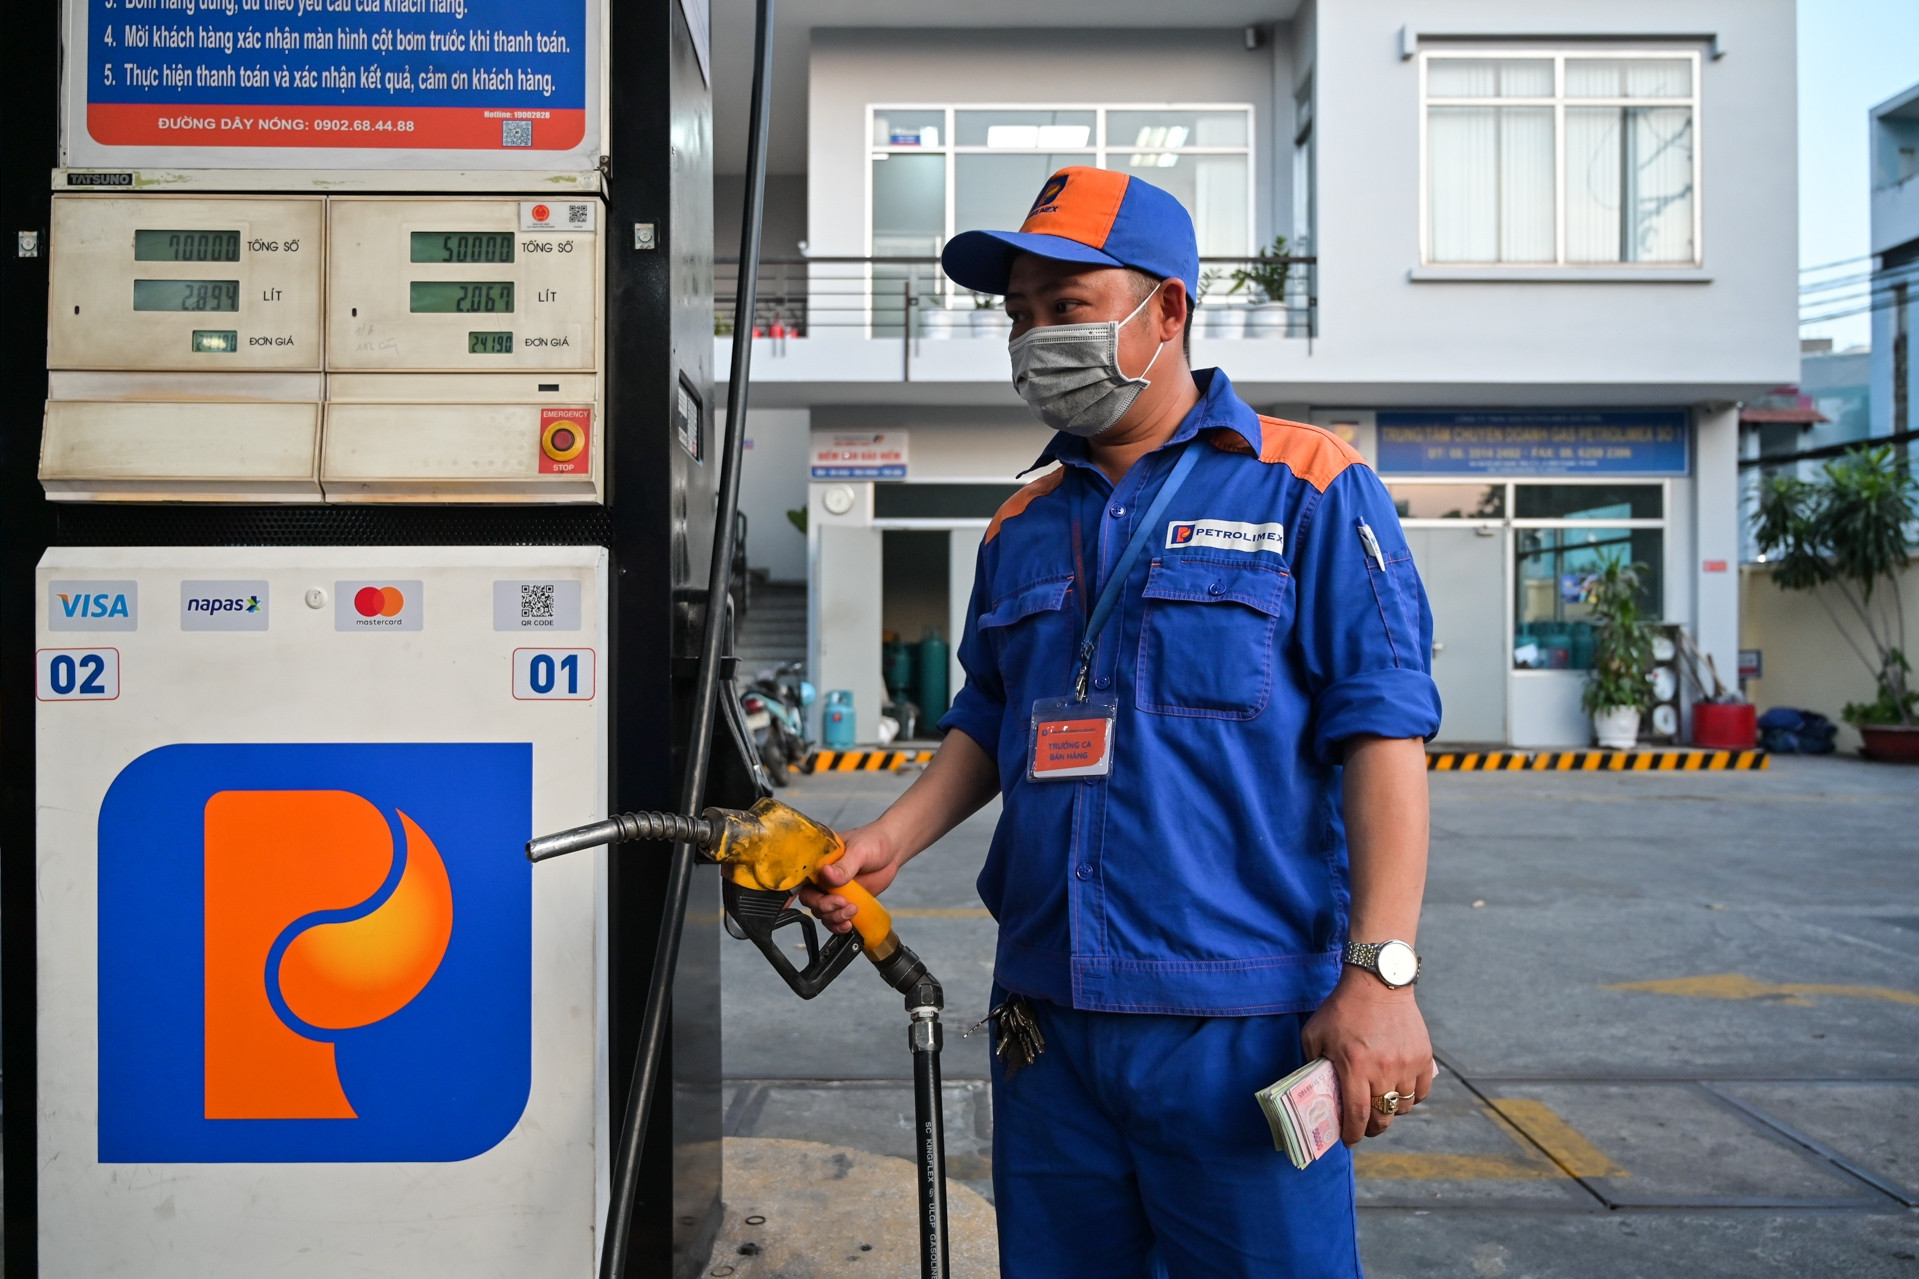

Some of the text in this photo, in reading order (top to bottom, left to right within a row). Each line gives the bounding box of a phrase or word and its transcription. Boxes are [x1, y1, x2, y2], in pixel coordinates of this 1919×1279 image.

[104, 24, 570, 55] 4. Mời khách hàng xác nhận màn hình cột bơm trước khi thanh toán.
[104, 63, 556, 97] 5. Thực hiện thanh toán và xác nhận kết quả, cảm ơn khách hàng.
[484, 110, 550, 119] Hotline: 19002828
[158, 114, 415, 132] ĐƯỜNG DÂY NÓNG: 0902.68.44.88
[70, 173, 130, 185] TATSUNO
[169, 235, 237, 260] 70000
[247, 236, 300, 253] TỔNG SỐ
[442, 235, 512, 263] 50000
[521, 238, 574, 254] TỔNG SỐ
[263, 287, 282, 302] LÍT
[456, 285, 511, 313] 2.067
[538, 288, 557, 303] LÍT
[249, 335, 294, 347] ĐƠN GIÁ
[525, 336, 570, 348] ĐƠN GIÁ
[543, 410, 589, 418] EMERGENCY
[553, 464, 575, 472] STOP
[1195, 528, 1284, 544] PETROLIMEX
[55, 593, 129, 618] VISA
[187, 597, 244, 616] napas
[356, 618, 402, 626] mastercard
[521, 619, 554, 627] QR CODE
[50, 653, 105, 695] 02
[529, 653, 578, 694] 01
[1081, 741, 1092, 749] CA
[925, 1121, 932, 1134] SC
[925, 1138, 935, 1183] KINGFLEX
[929, 1233, 938, 1279] GASOLINE
